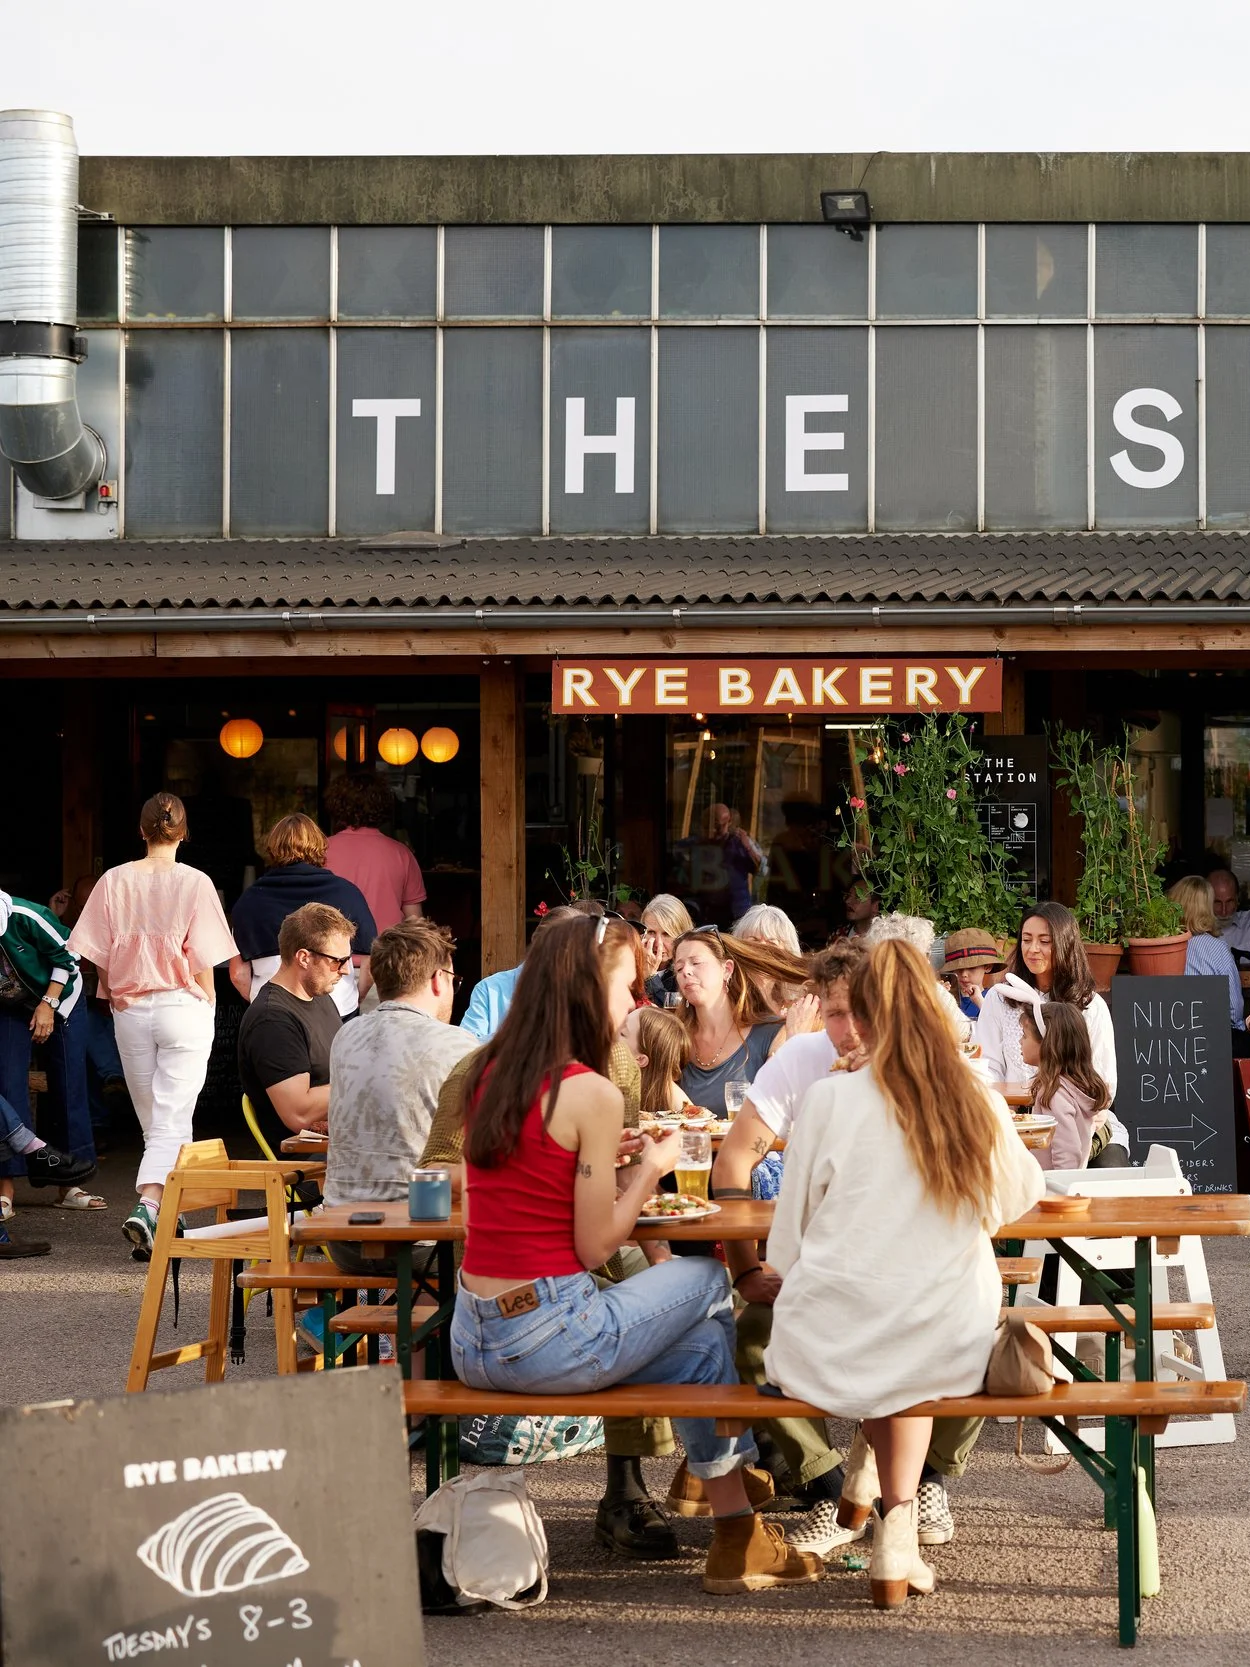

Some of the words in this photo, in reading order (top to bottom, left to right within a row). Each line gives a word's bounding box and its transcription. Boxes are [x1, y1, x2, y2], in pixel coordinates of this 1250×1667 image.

[351, 394, 850, 496] THE
[562, 666, 689, 707] RYE
[718, 666, 987, 707] BAKERY
[985, 758, 1014, 768] THE
[1133, 1000, 1204, 1031] NICE
[1133, 1036, 1208, 1066] WINE
[1205, 1184, 1233, 1193] DRINKS
[501, 1292, 535, 1313] Lee
[124, 1460, 178, 1488] RYE
[183, 1448, 287, 1482] BAKERY
